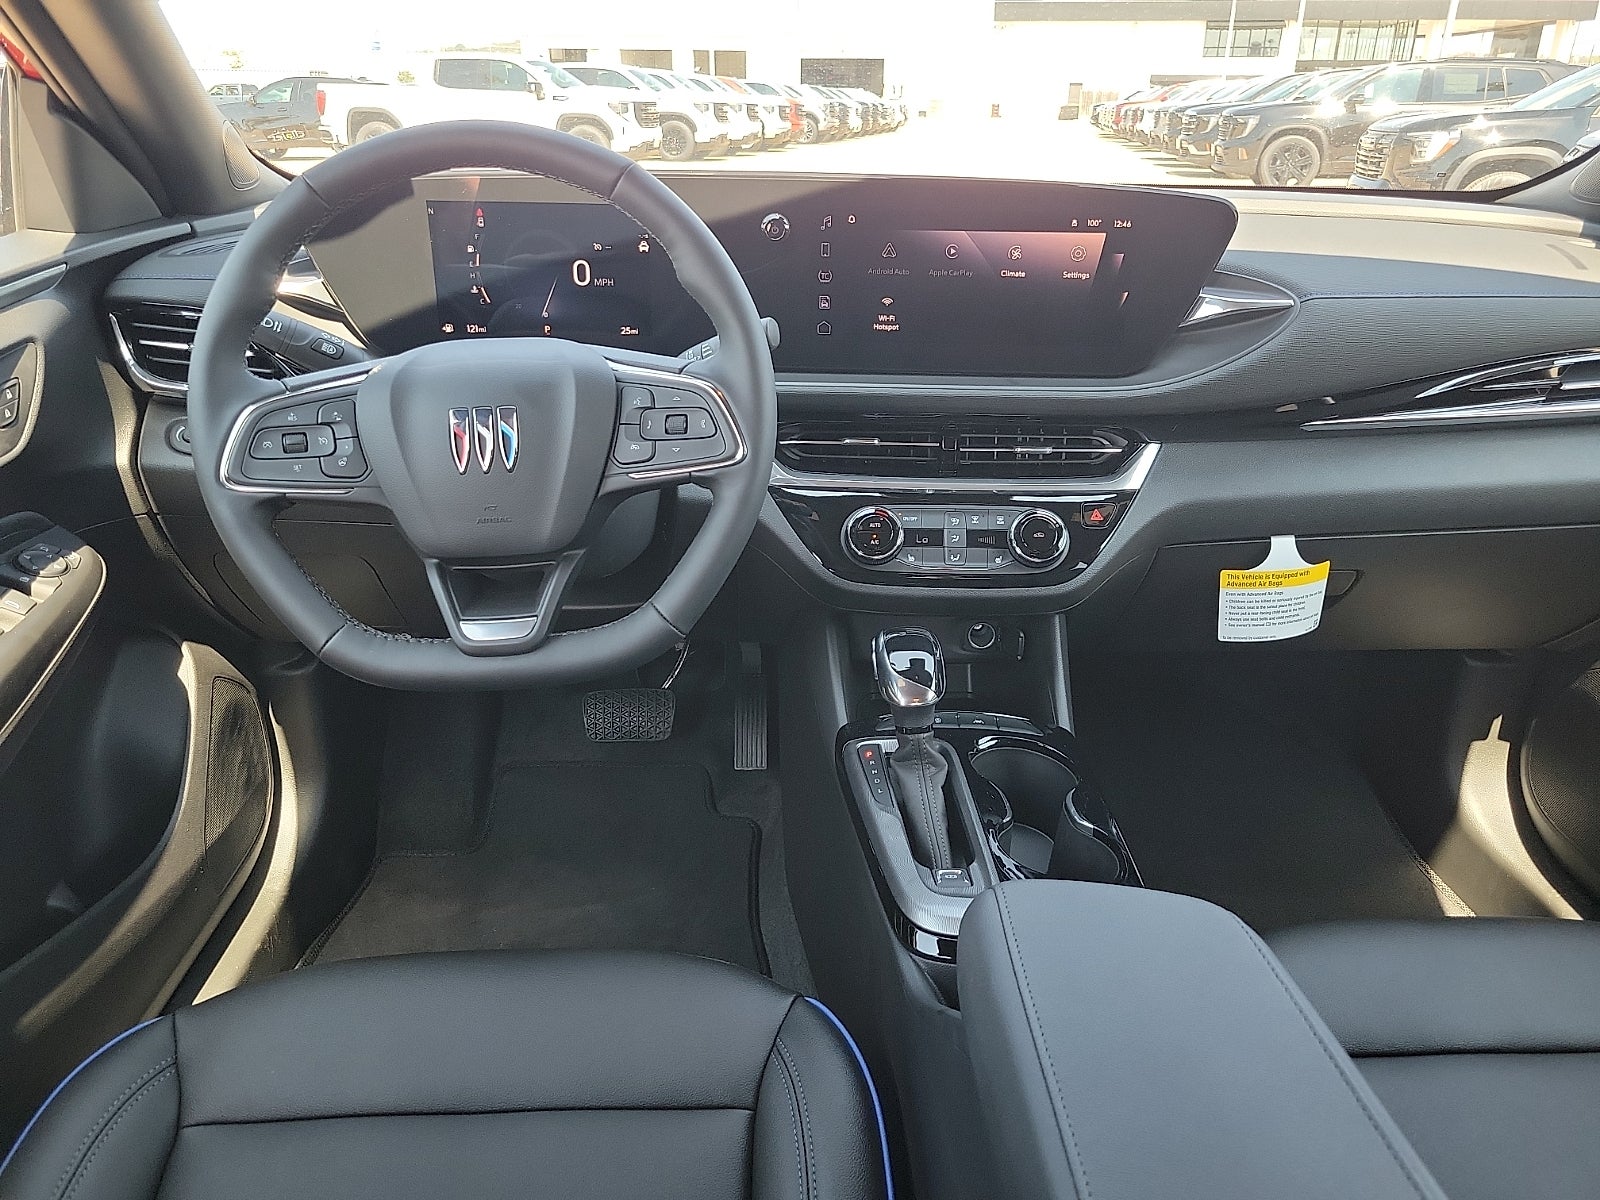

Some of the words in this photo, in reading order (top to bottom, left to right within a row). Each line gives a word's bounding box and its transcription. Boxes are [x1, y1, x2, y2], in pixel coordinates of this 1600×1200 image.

[1114, 220, 1132, 228] 12:46
[572, 259, 591, 287] 0
[868, 267, 892, 276] Android
[894, 268, 910, 276] Auto
[929, 269, 947, 278] Apple
[949, 269, 973, 278] CarPlay
[1000, 270, 1026, 278] Climate
[1063, 271, 1090, 280] Settings
[594, 278, 614, 287] MPH
[466, 325, 487, 333] 121mi
[544, 325, 551, 333] P
[620, 327, 639, 335] 25mi
[873, 323, 899, 331] Hotspot
[1272, 571, 1298, 580] Equipped
